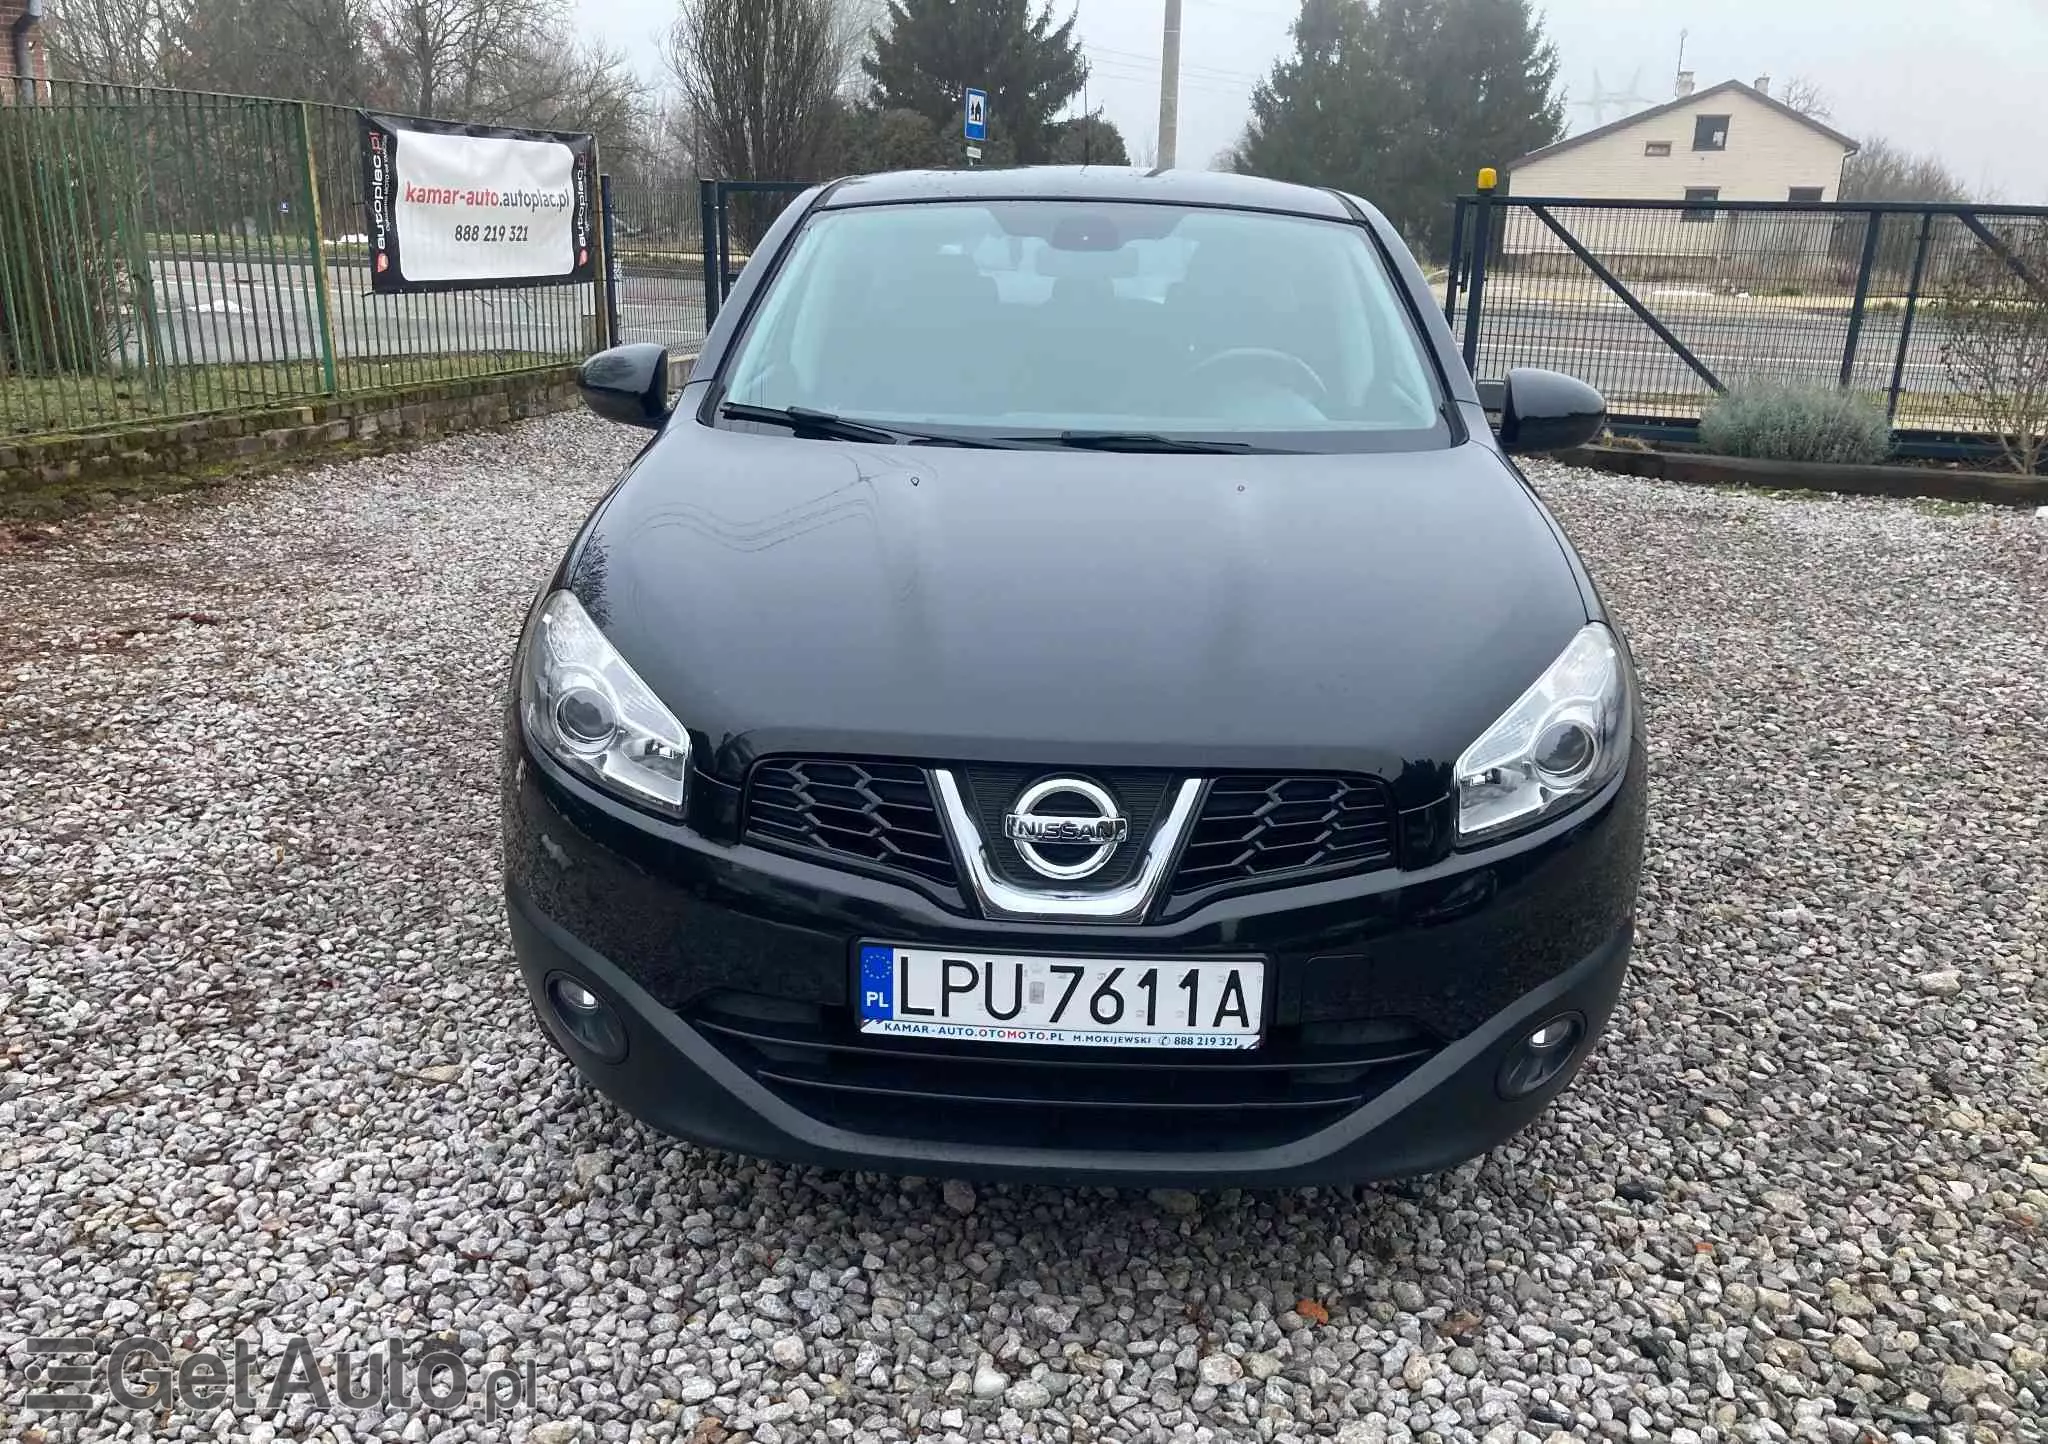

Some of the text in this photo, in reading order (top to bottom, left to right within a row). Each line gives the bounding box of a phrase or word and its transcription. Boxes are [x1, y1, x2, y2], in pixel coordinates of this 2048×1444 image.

[368, 131, 385, 250] autoplac.pl
[405, 181, 570, 213] kamar-auto.autoplac.pl
[455, 224, 529, 242] 888 219 321
[1016, 820, 1115, 839] NISSAN
[866, 991, 889, 1009] PL
[900, 955, 1250, 1028] LPU 7611A
[1174, 1036, 1194, 1046] 888
[1197, 1036, 1215, 1046] 219
[1219, 1037, 1238, 1047] 321
